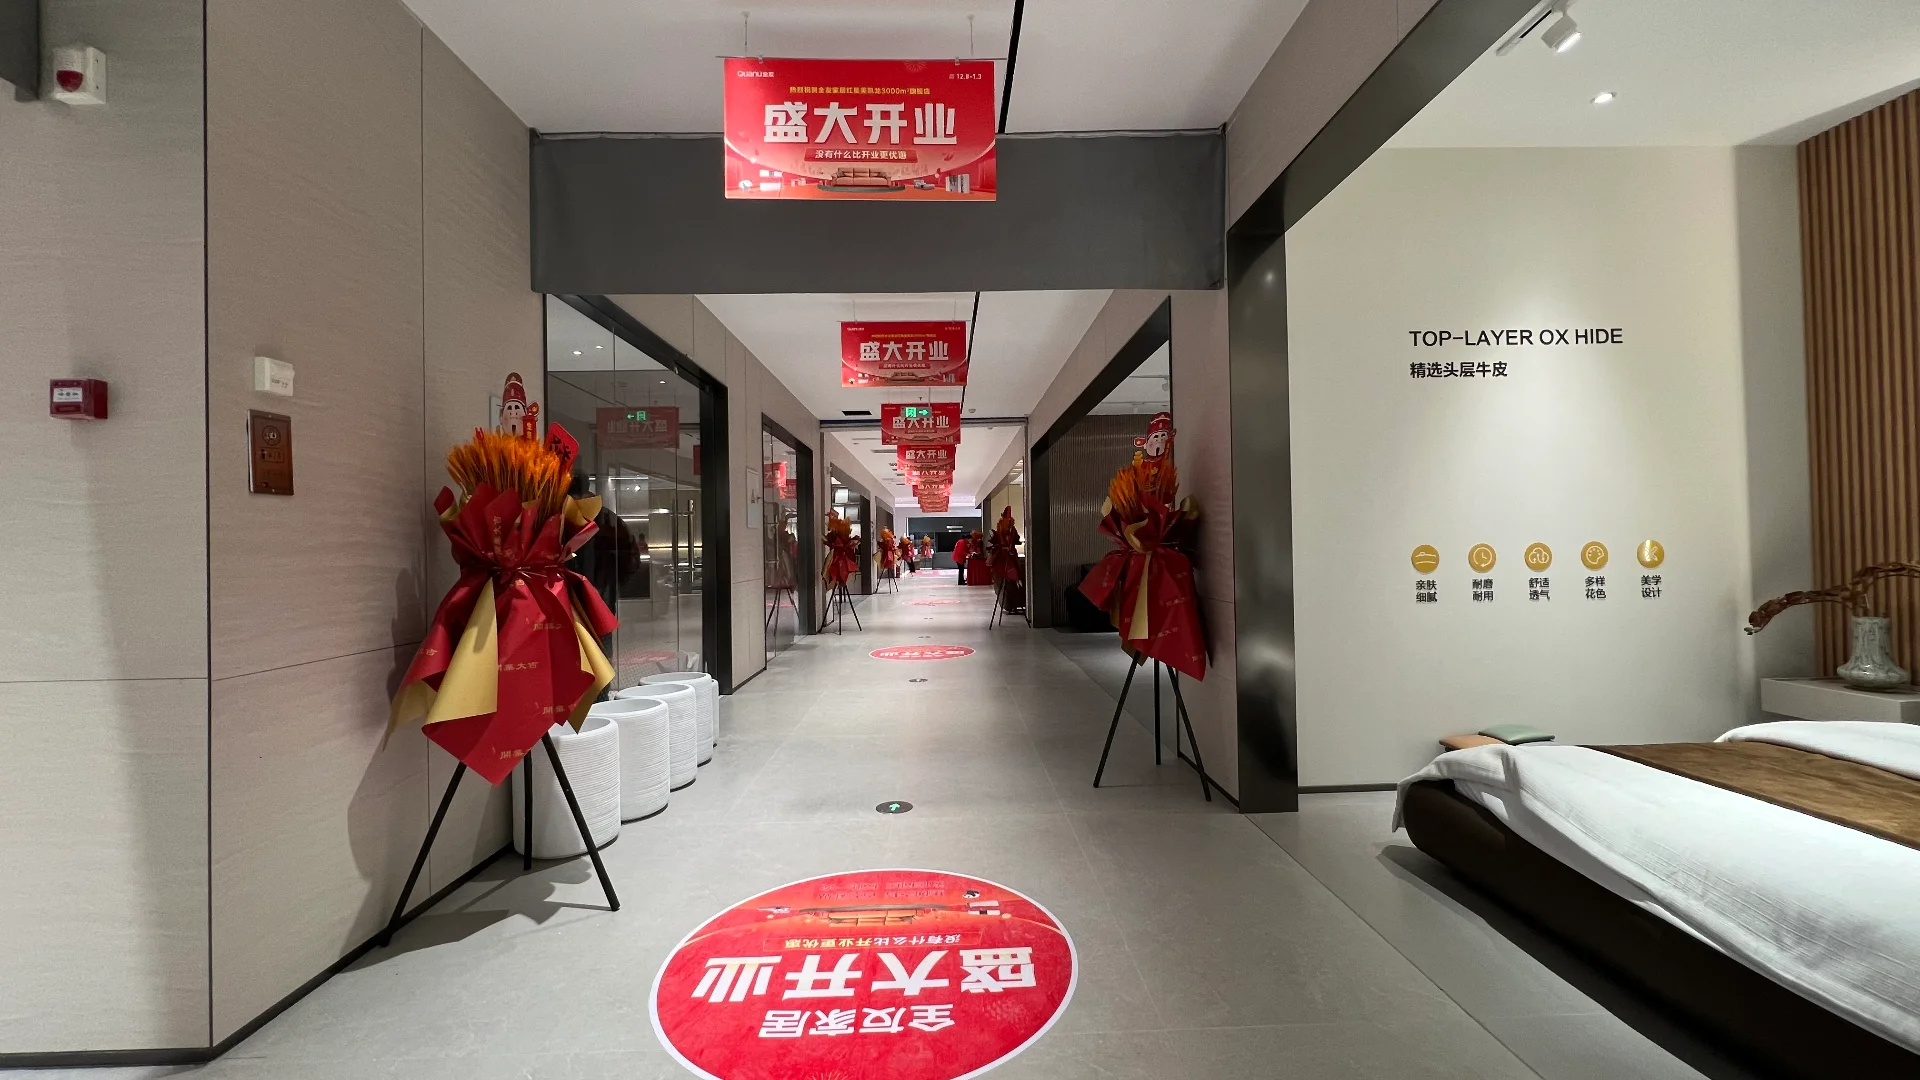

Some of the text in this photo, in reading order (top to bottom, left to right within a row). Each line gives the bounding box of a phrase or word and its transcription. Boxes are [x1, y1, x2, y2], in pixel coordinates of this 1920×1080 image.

[764, 102, 957, 145] 盛大开业
[815, 150, 907, 160] 没有什么比开业更优惠
[1409, 328, 1623, 347] TOP-LAYER OX HIDE
[860, 341, 949, 361] 盛大开业
[1410, 361, 1508, 378] 精选头层牛皮
[906, 450, 947, 460] 盛大开业
[1416, 580, 1437, 591] 亲肤
[1472, 579, 1493, 590] 耐磨
[1529, 577, 1550, 589] 舒适
[1585, 576, 1606, 587] 多样
[1641, 574, 1662, 586] 美学
[1416, 591, 1438, 603] 细腻
[1472, 590, 1494, 602] 耐用
[1529, 589, 1551, 601] 透气
[1585, 588, 1606, 599] 花色
[1641, 587, 1662, 598] 设计
[785, 933, 961, 949] 没有什么比开业更优惠
[691, 946, 1037, 1003] 盛大开业
[758, 1003, 955, 1038] 全友家居
